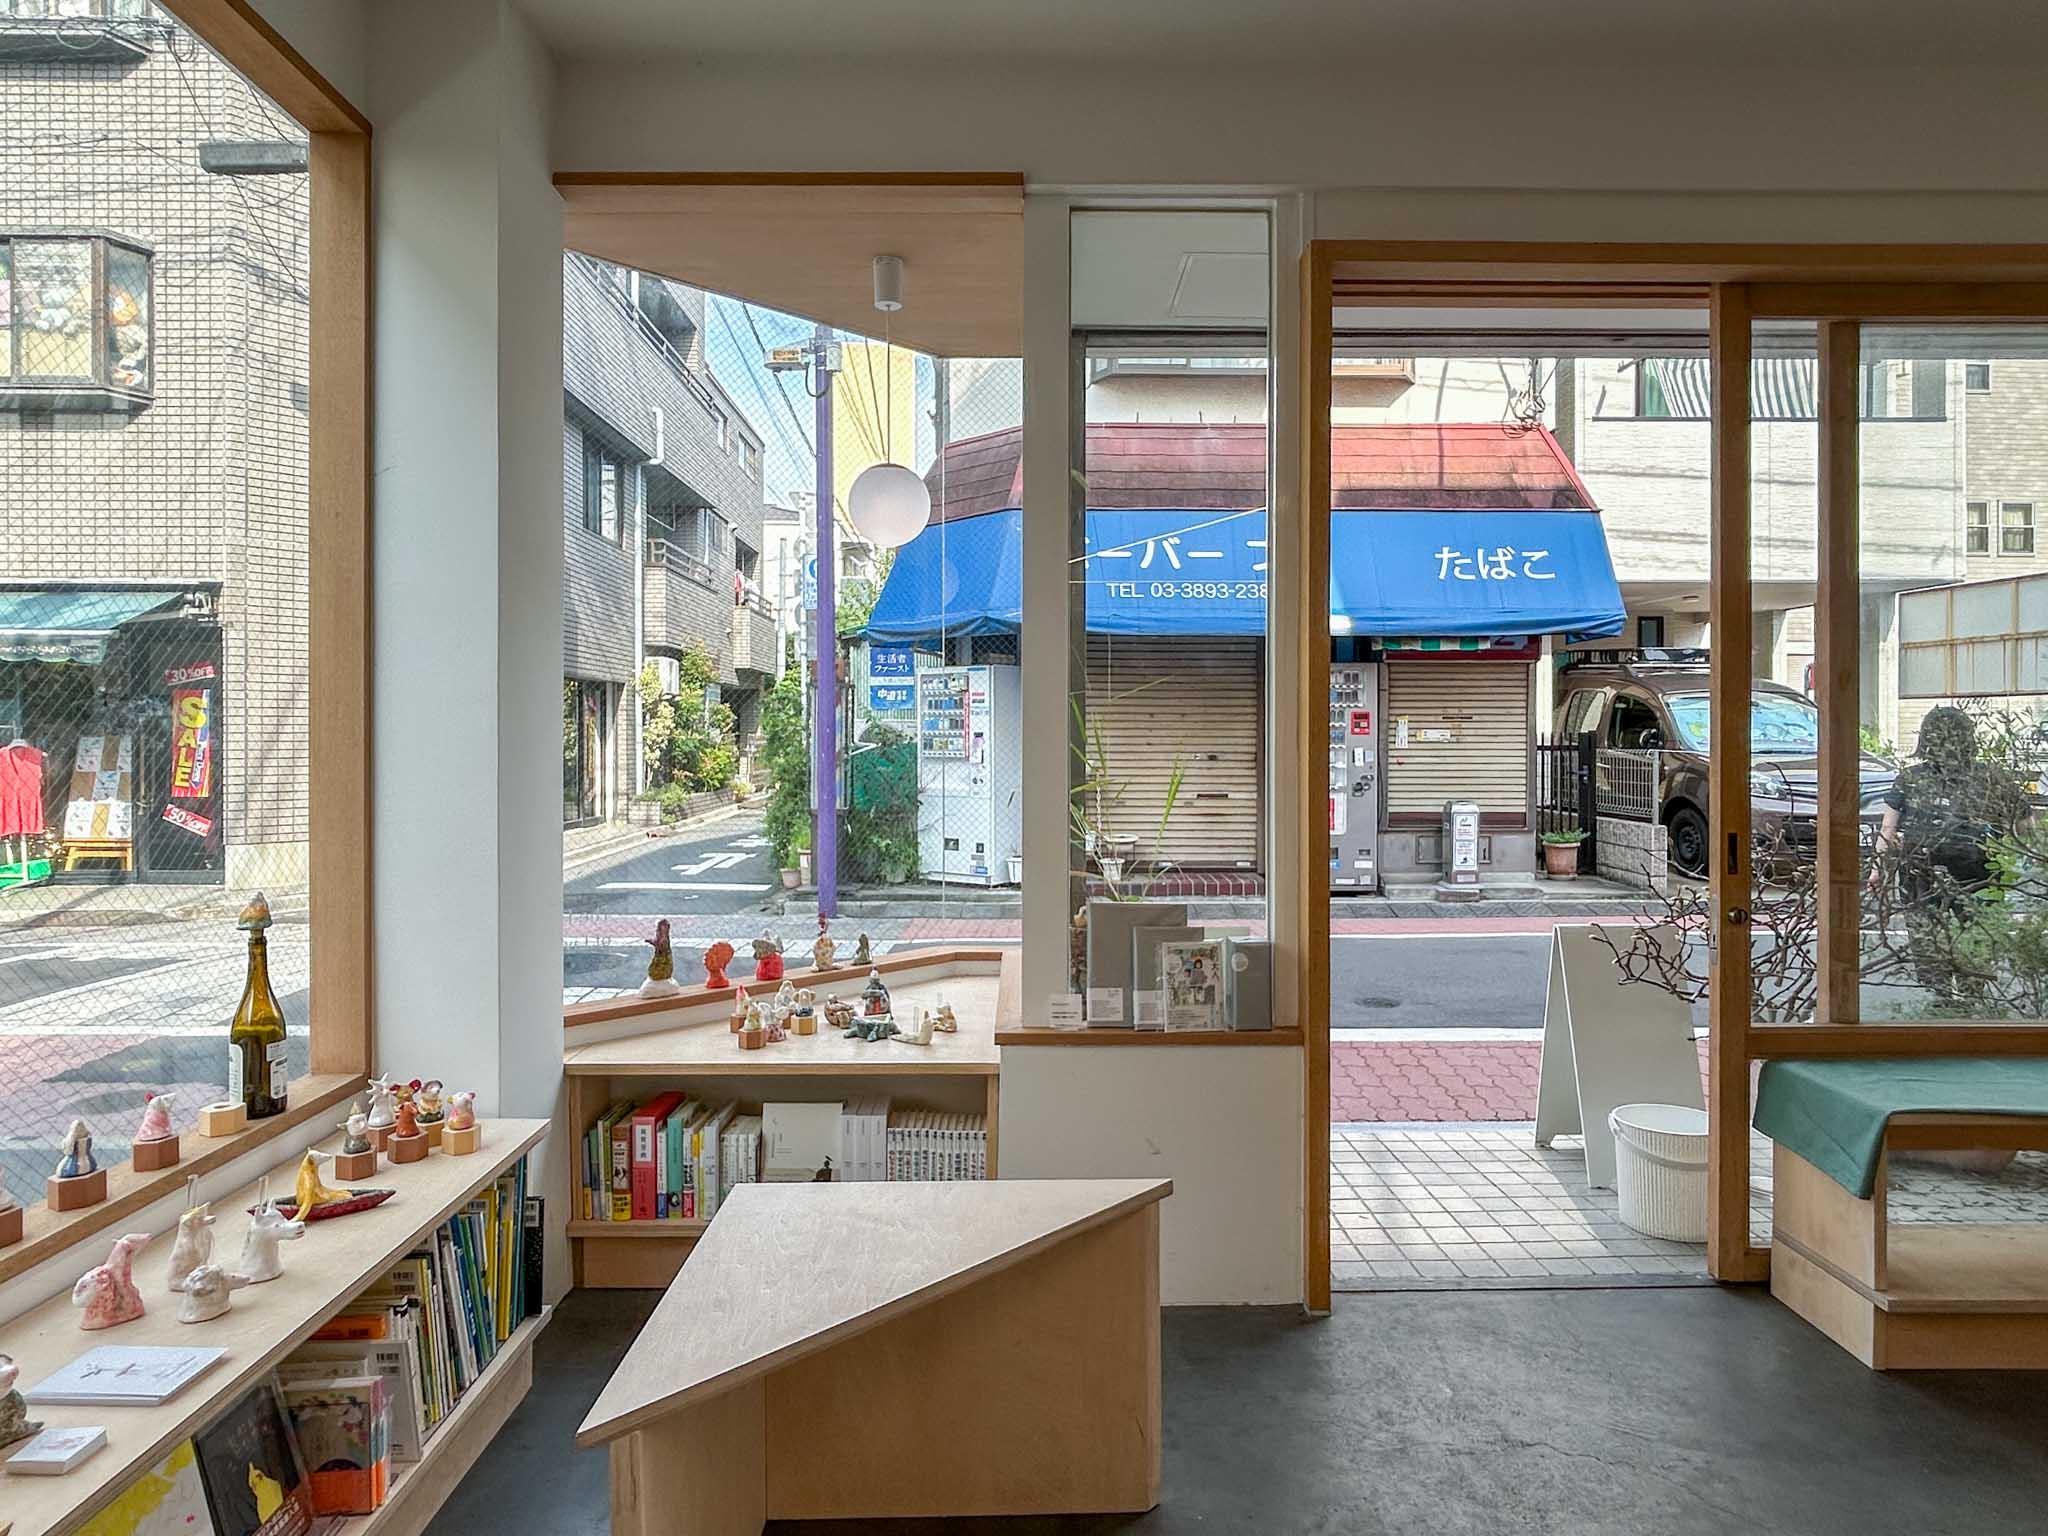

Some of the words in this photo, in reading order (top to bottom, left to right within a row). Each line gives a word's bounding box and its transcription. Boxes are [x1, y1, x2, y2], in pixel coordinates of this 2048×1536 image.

[1434, 545, 1556, 581] たばこ
[1106, 583, 1144, 598] TEL
[877, 653, 906, 664] 生活者
[874, 664, 909, 673] ファースト
[175, 696, 208, 787] SALE
